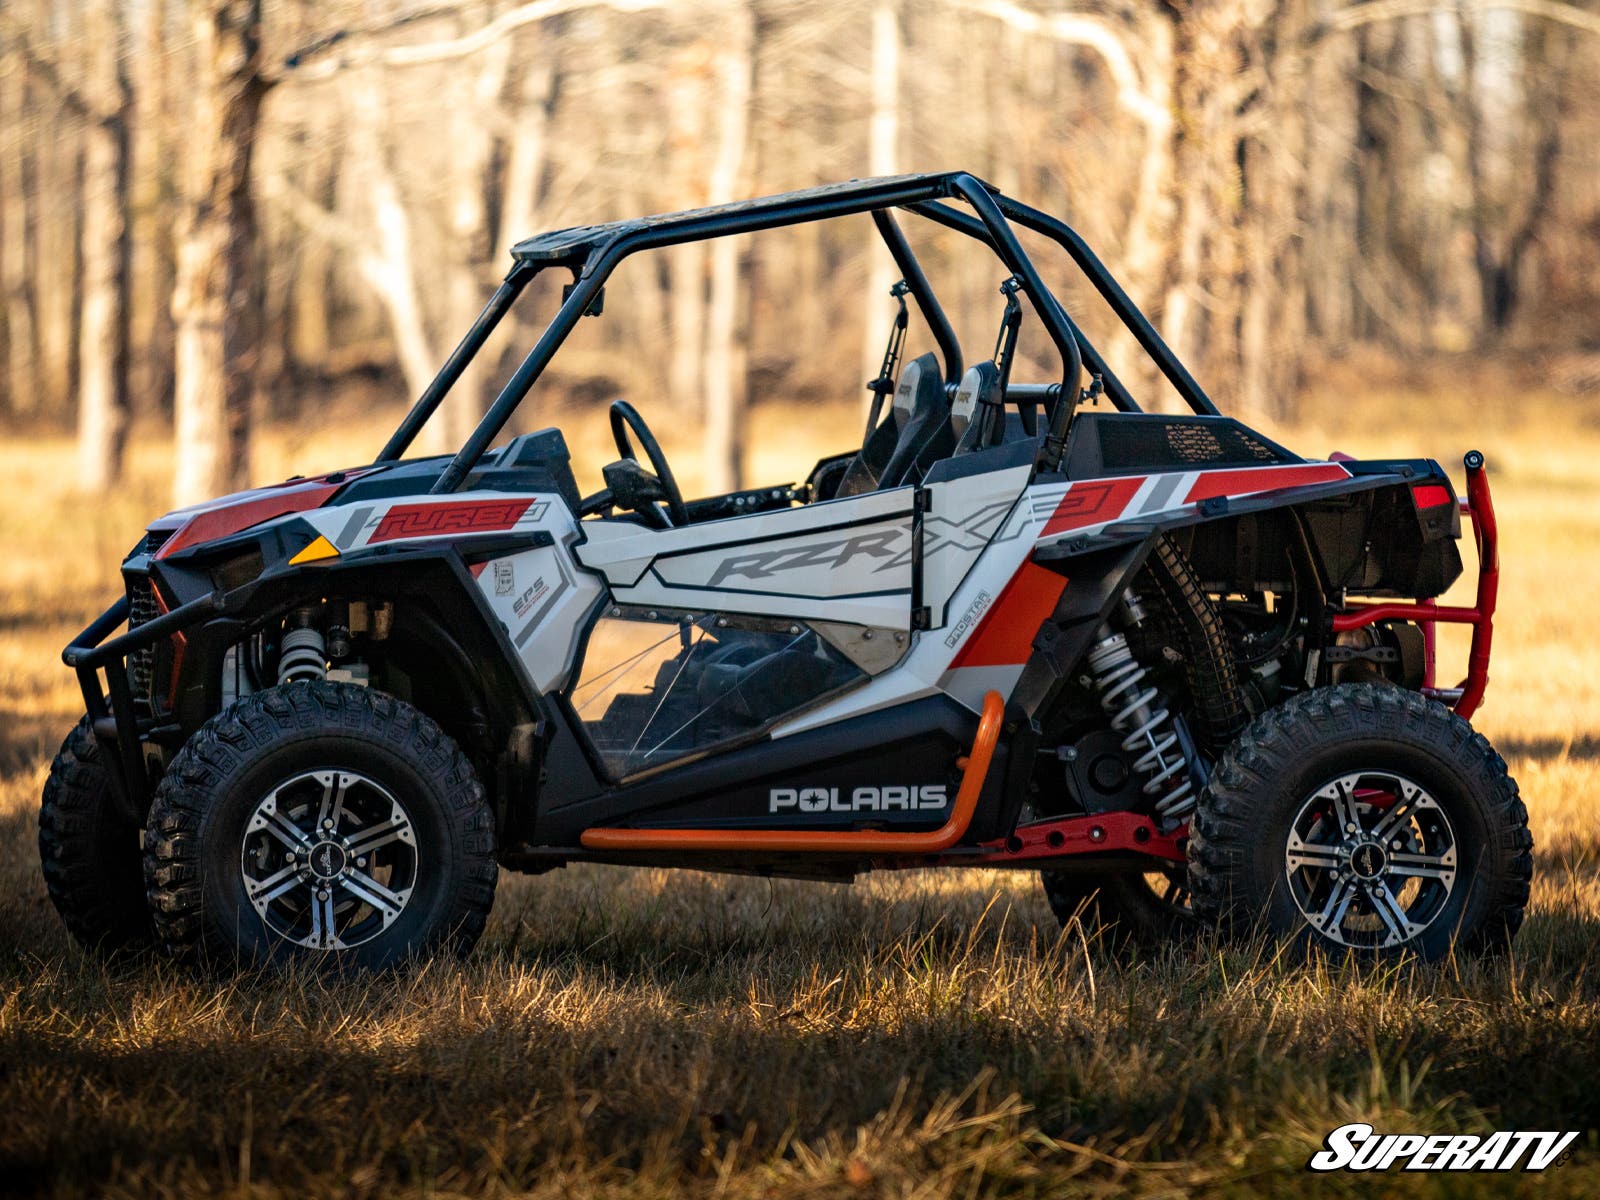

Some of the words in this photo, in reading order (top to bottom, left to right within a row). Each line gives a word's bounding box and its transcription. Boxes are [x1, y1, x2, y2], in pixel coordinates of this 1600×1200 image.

[365, 501, 551, 537] TURBO
[706, 528, 904, 586] RZR
[513, 576, 544, 614] EPS
[944, 590, 990, 649] PROSTAR
[769, 785, 948, 813] POLARIS
